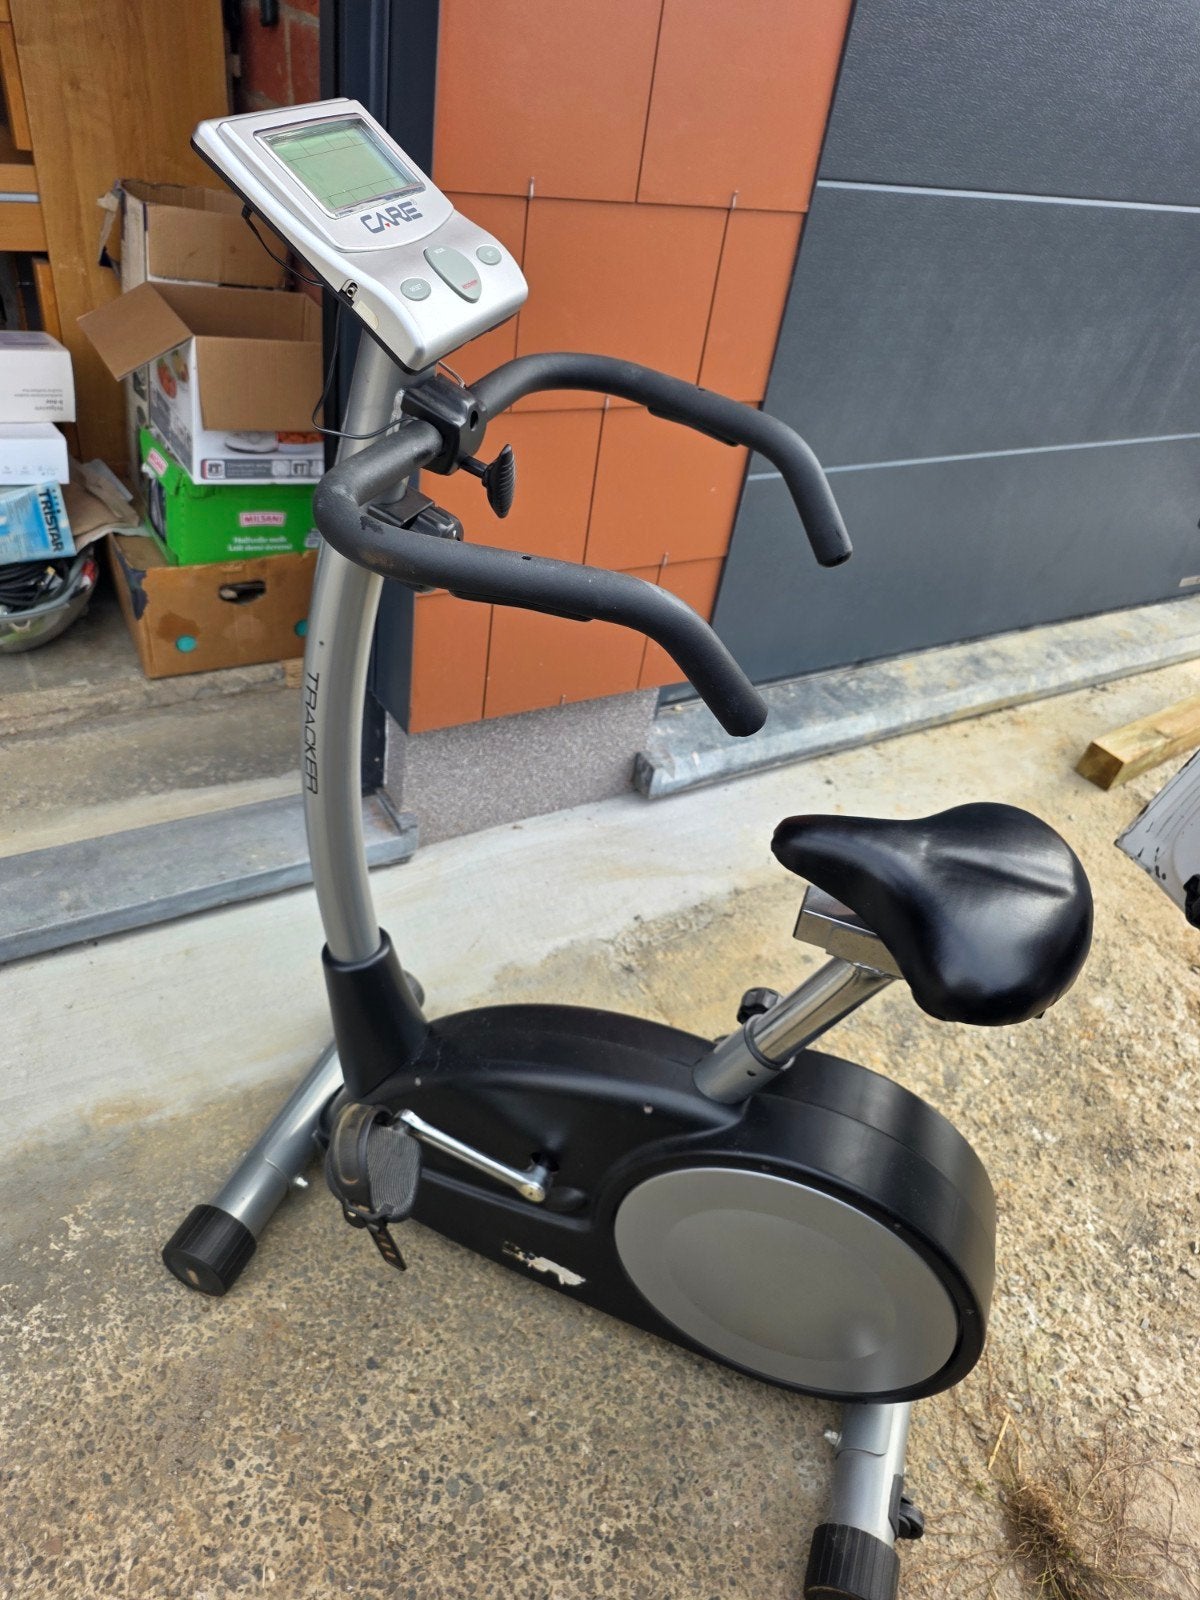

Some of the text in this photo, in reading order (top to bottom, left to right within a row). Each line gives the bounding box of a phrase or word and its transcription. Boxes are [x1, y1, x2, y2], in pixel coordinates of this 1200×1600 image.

[360, 201, 423, 234] CARE
[38, 488, 65, 553] TRISTAR
[243, 513, 283, 525] MILSANI
[304, 672, 320, 795] TRACKER
